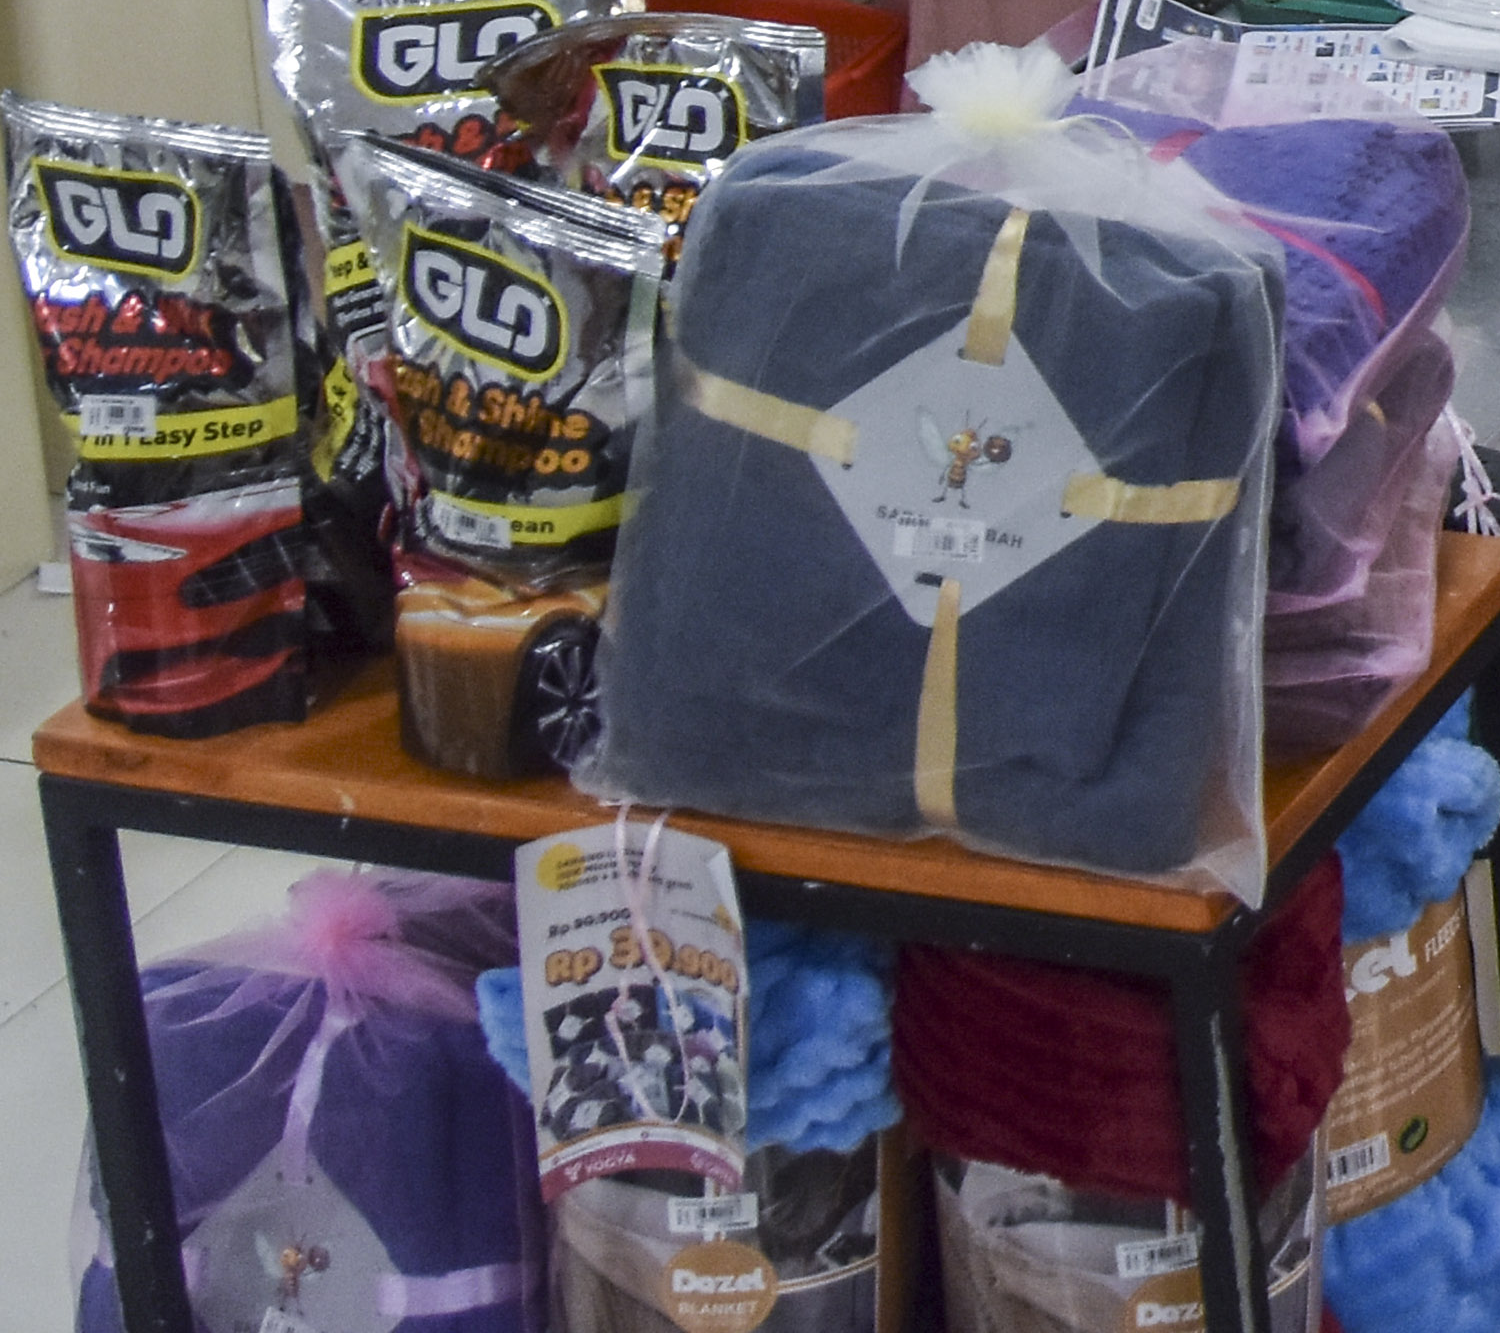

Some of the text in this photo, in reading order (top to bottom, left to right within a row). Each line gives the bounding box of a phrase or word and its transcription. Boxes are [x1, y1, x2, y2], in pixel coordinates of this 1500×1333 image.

[377, 15, 541, 88] GLO
[617, 78, 724, 152] GLO
[55, 179, 189, 260] GLO
[412, 247, 550, 358] GLO
[56, 336, 233, 383] Shampoo
[140, 416, 265, 448] Easy Step
[477, 384, 592, 441] Shine
[510, 518, 555, 536] ean
[543, 945, 601, 988] Rp
[678, 1299, 759, 1318] BLANKET
